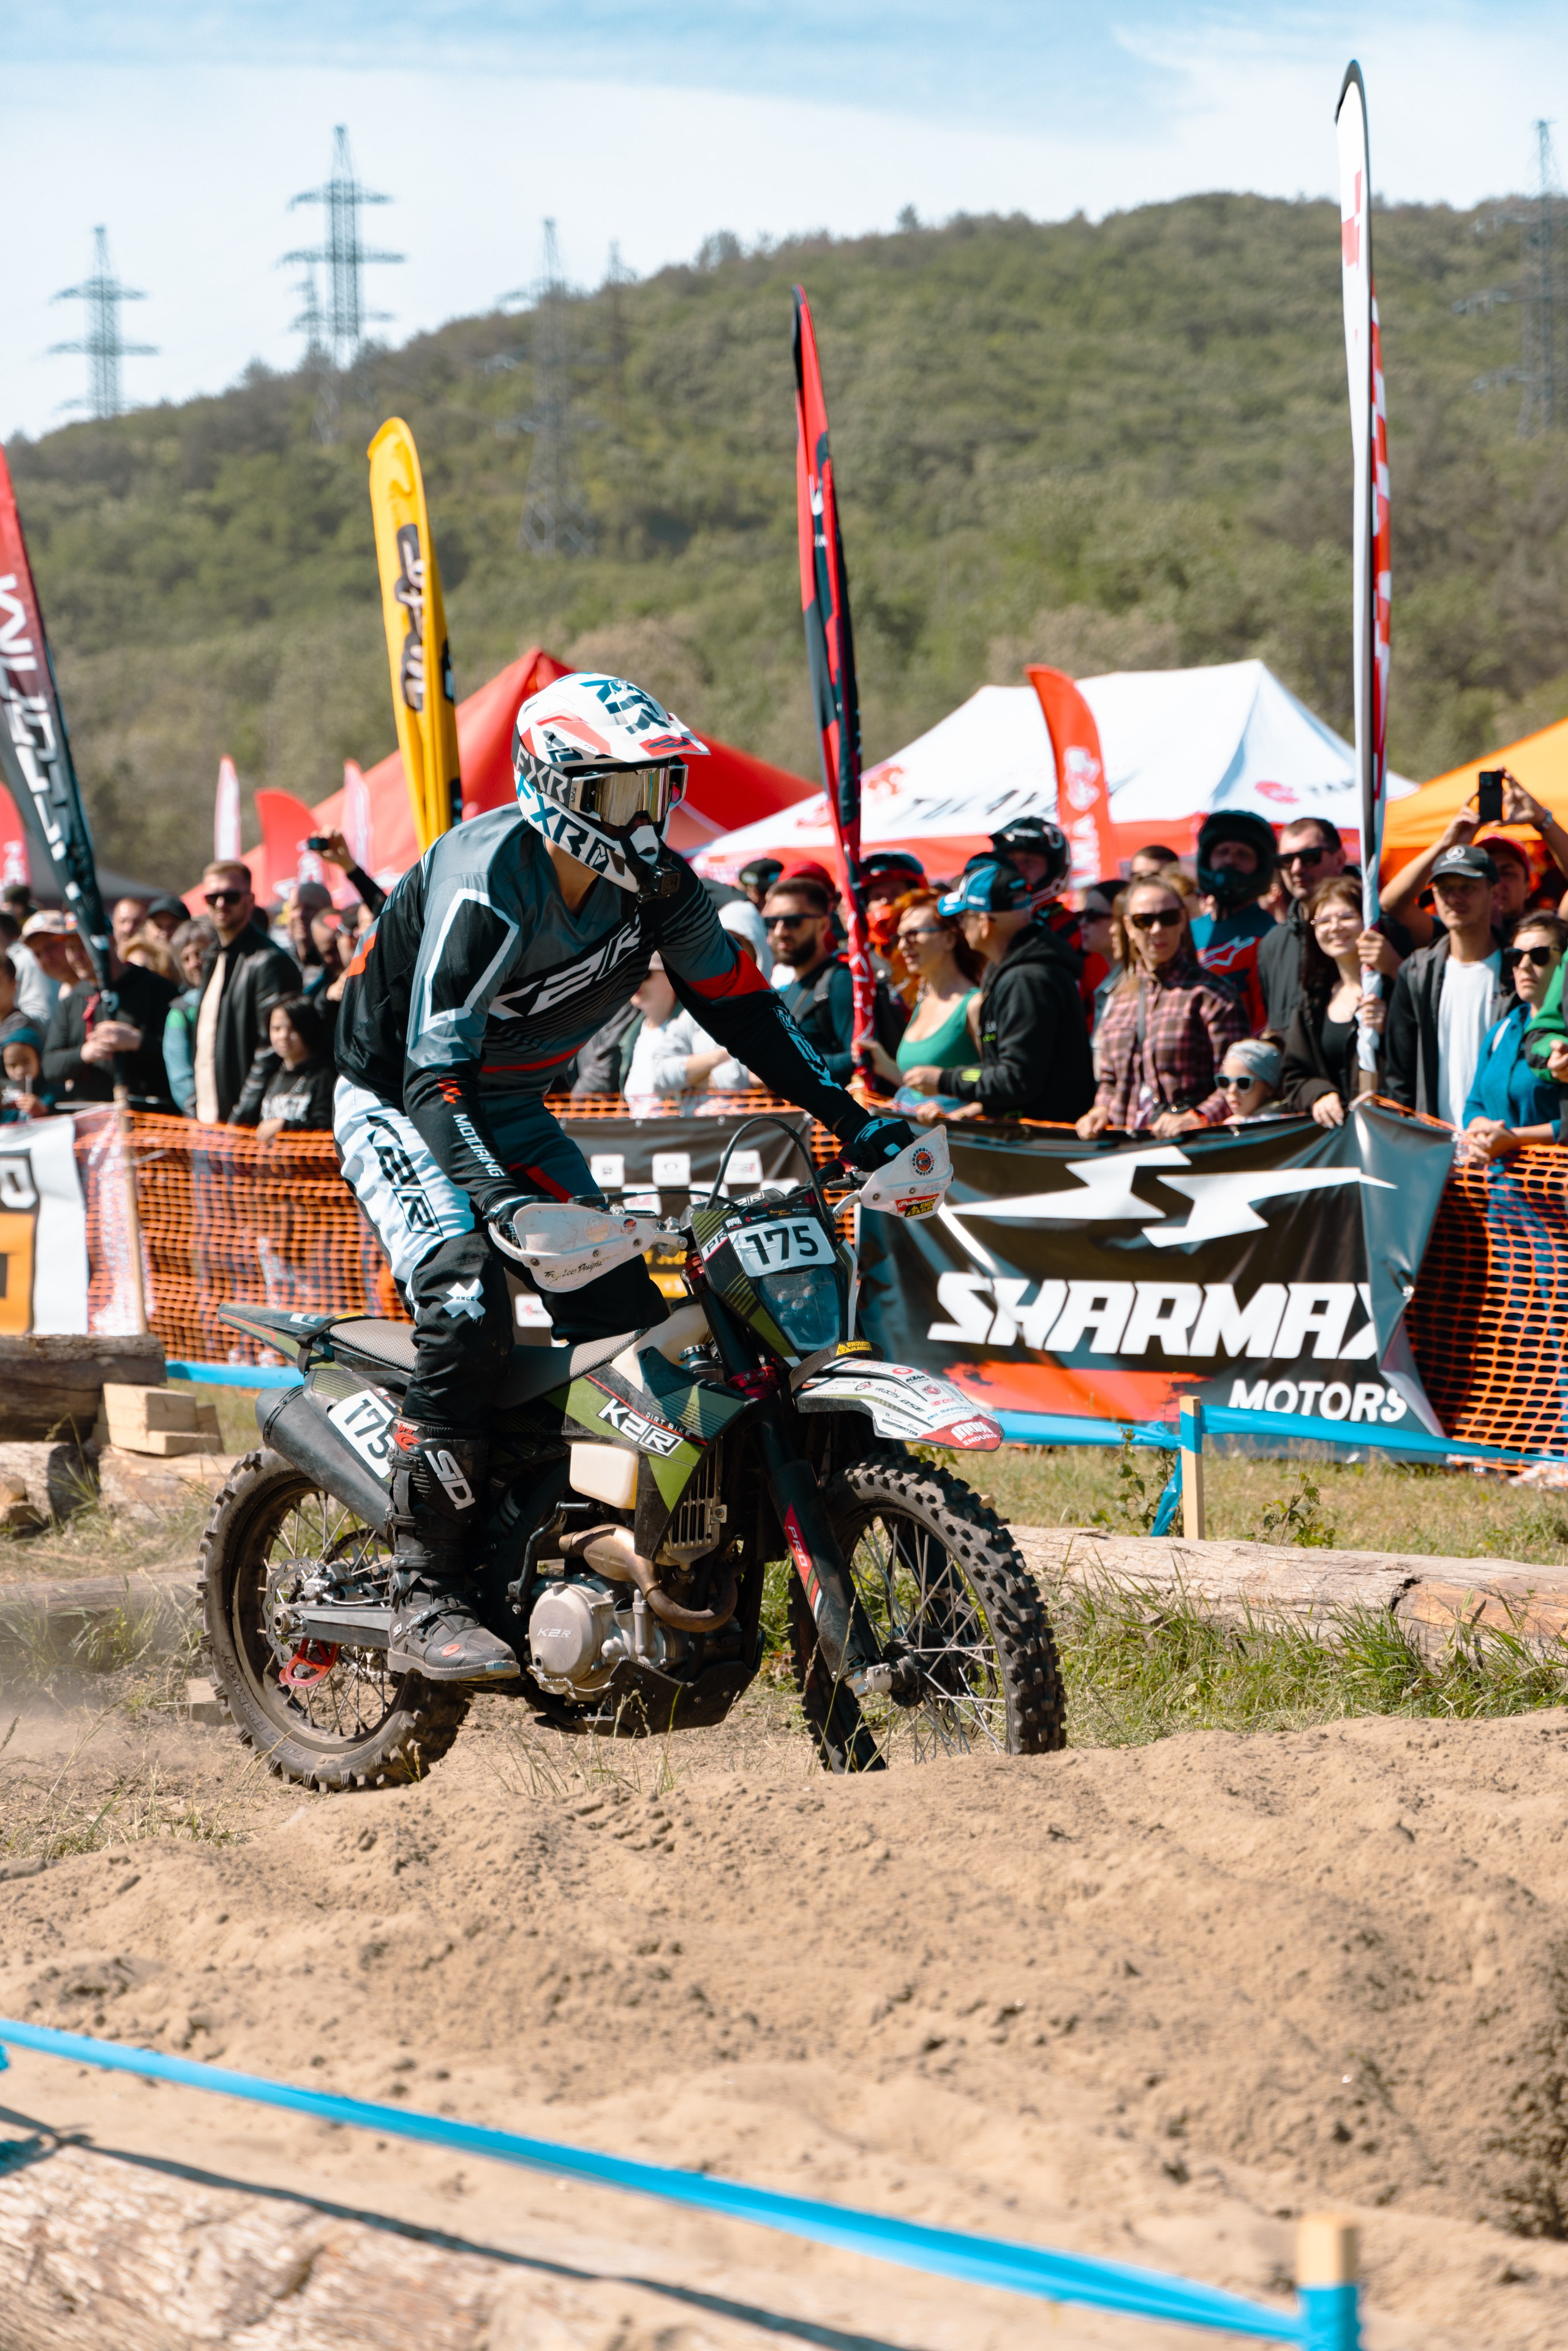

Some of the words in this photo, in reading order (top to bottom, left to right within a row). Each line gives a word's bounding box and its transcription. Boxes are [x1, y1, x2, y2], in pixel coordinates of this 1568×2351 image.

[515, 744, 568, 804] FXR
[516, 773, 590, 858] FXR
[453, 1114, 505, 1178] MOTORING
[744, 1225, 819, 1266] 175
[578, 1260, 602, 1273] Designs
[875, 1387, 900, 1399] VELOCITY
[1227, 1378, 1408, 1422] MOTORS
[344, 1398, 391, 1460] 175
[598, 1397, 684, 1457] K2R
[645, 1412, 666, 1426] DIRT
[667, 1423, 692, 1437] BIKE
[962, 1433, 998, 1446] ENDURO
[788, 1526, 809, 1567] PRO
[537, 1628, 573, 1639] K2R
